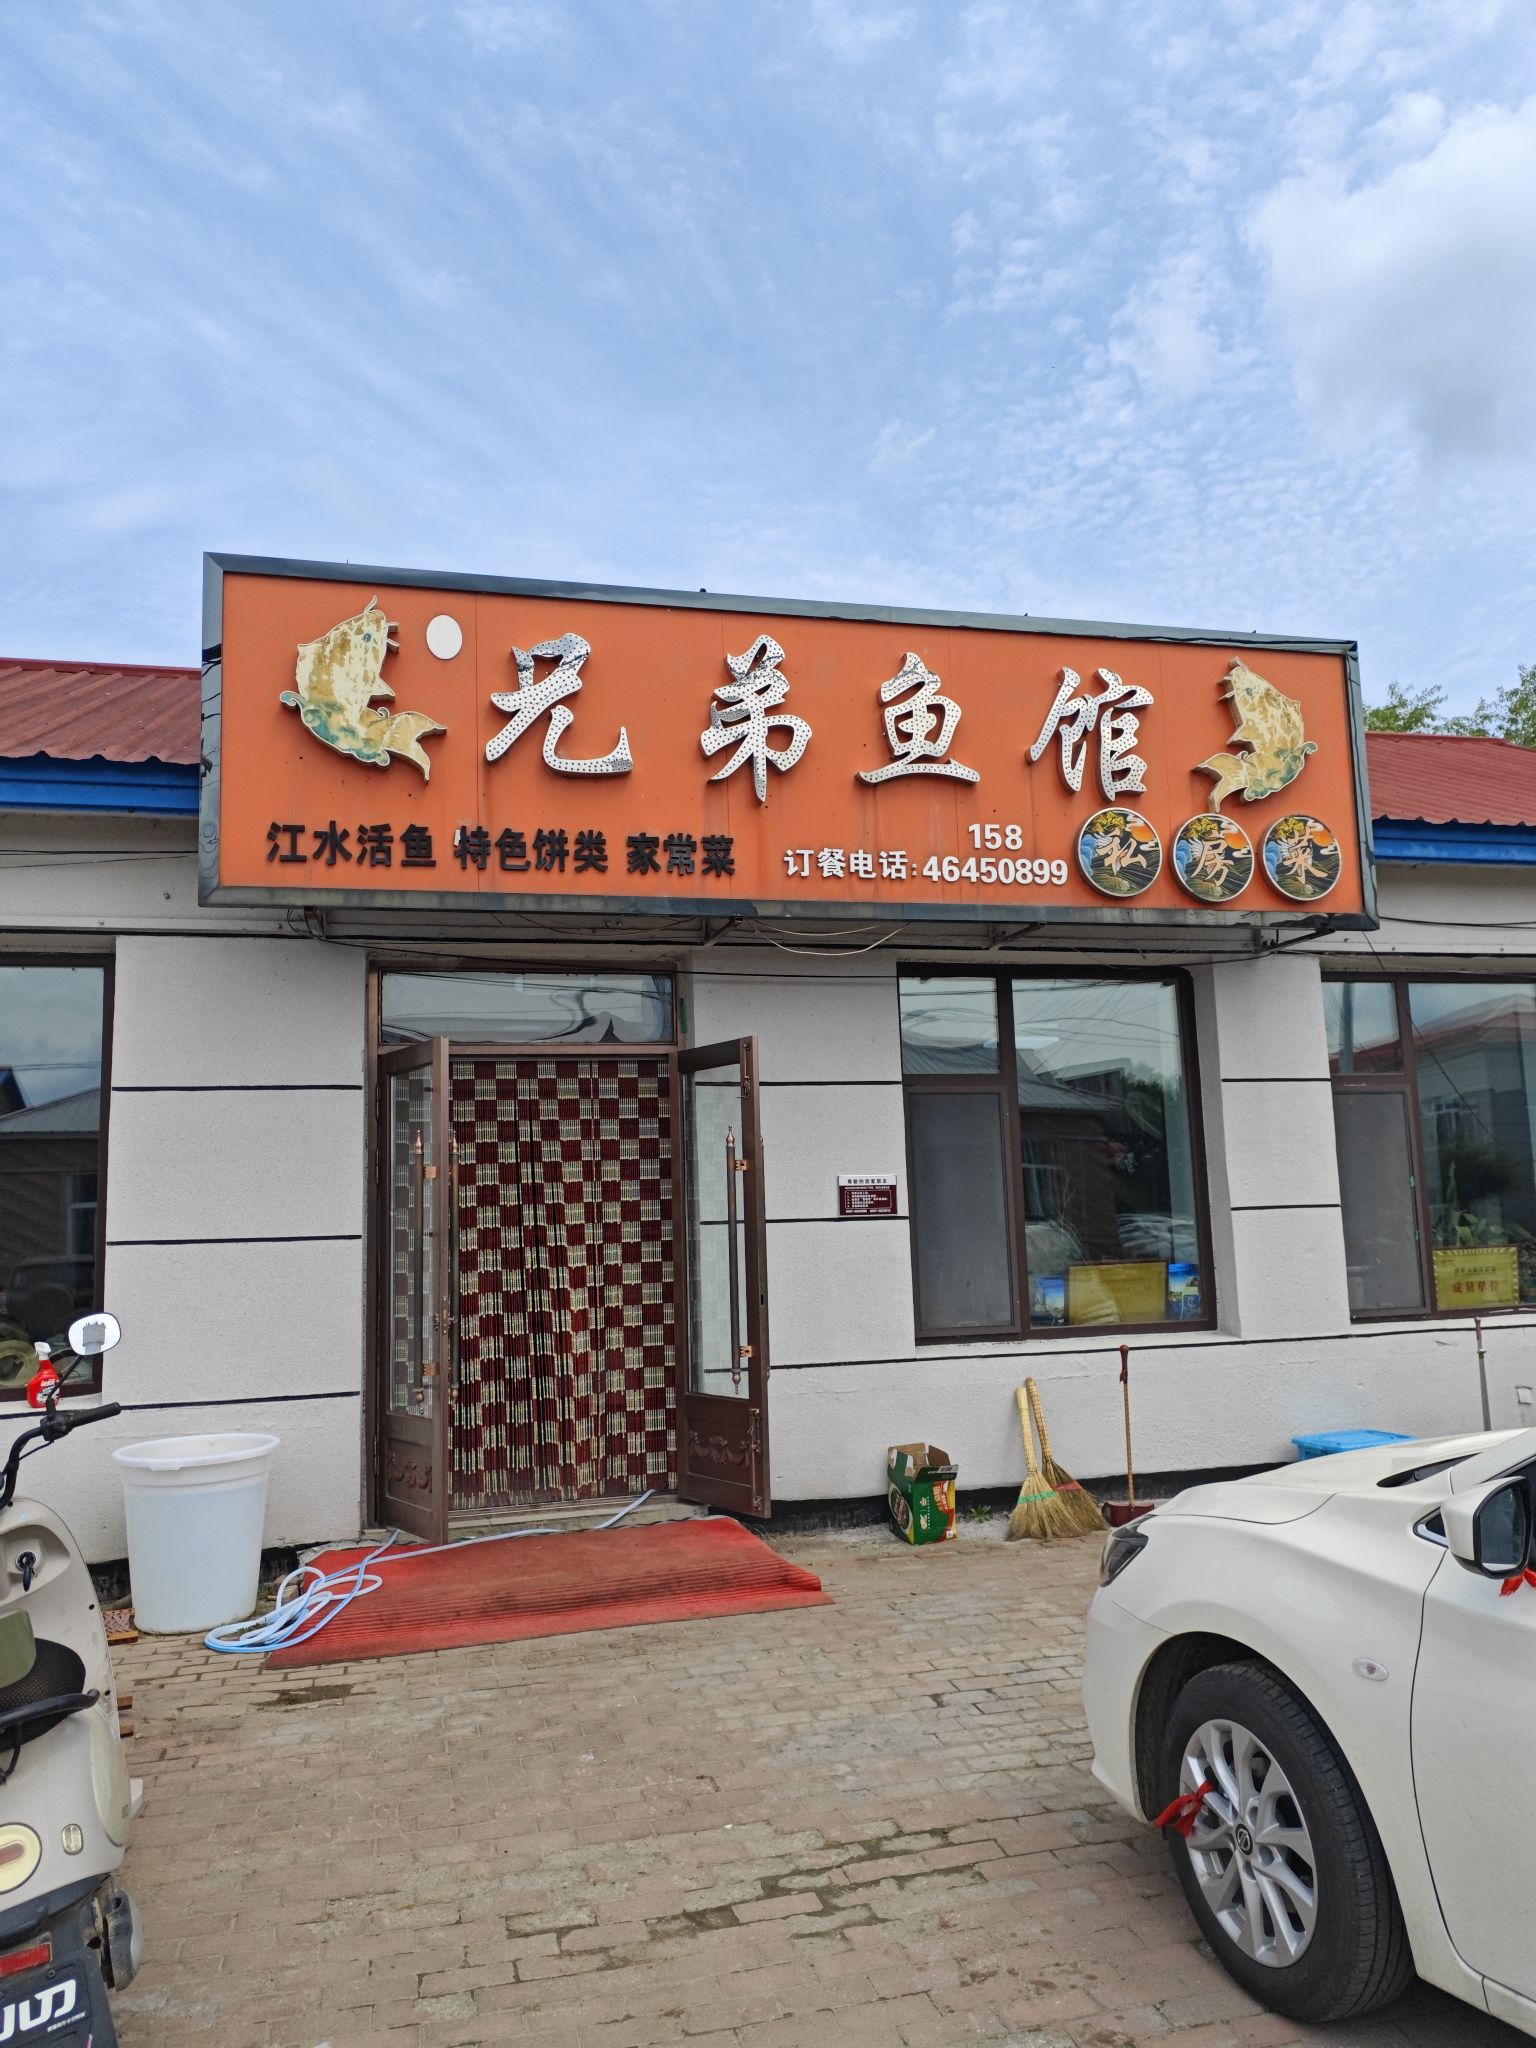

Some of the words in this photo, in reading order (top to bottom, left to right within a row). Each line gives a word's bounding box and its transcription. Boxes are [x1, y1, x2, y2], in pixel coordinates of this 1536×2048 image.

[484, 631, 1156, 803] 兄弟鱼馆
[267, 820, 437, 868] 江水活鱼
[456, 826, 608, 874] 特色饼类
[627, 832, 736, 877] 家常菜
[969, 824, 1022, 850] 158
